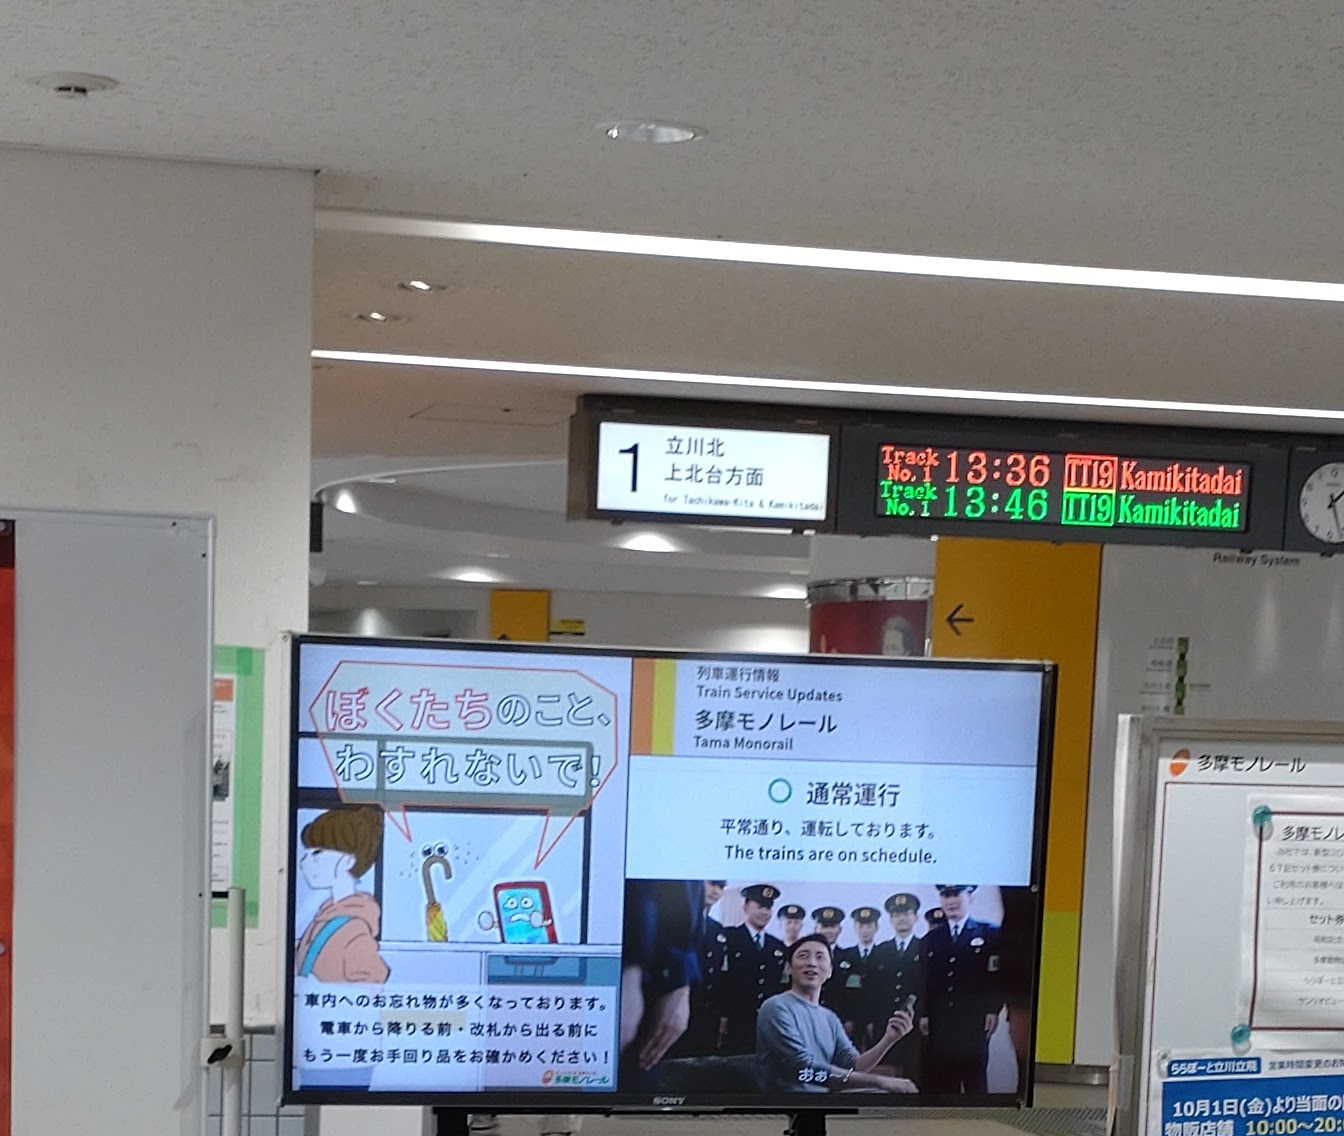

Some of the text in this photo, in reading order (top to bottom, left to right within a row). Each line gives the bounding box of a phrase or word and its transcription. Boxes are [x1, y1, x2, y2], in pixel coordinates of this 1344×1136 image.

[665, 435, 725, 457] 立川北
[618, 442, 640, 493] 1
[664, 463, 764, 486] 上北台方面
[881, 447, 1242, 495] Track 13:36 TT19 Kamikitadai
[880, 481, 1240, 529] Track 13:46 TT19 Kamikitadai
[1213, 552, 1301, 568] Railway System
[697, 666, 780, 683] 列車運行情報
[696, 685, 843, 703] Train Service Updates
[325, 686, 612, 733] ぼくたちのこと、
[695, 709, 838, 733] 多摩モノレール
[694, 736, 794, 751] Tama Monorail
[335, 743, 602, 788] わすれないで!
[1197, 754, 1306, 774] 多摩モノレール
[806, 781, 901, 807] 通常運行
[720, 818, 935, 840] 平常通り、運転しております。
[724, 845, 938, 864] The trains are on schedule.
[304, 992, 608, 1010] 車内へのお忘れ物が多くなっております。
[320, 1021, 598, 1038] 電車から降りる前・改札から出る前に
[303, 1048, 610, 1065] もう一度お手回り品をお確かめください!
[554, 1074, 610, 1086] 多摩モノレール
[653, 1096, 686, 1105] SONY
